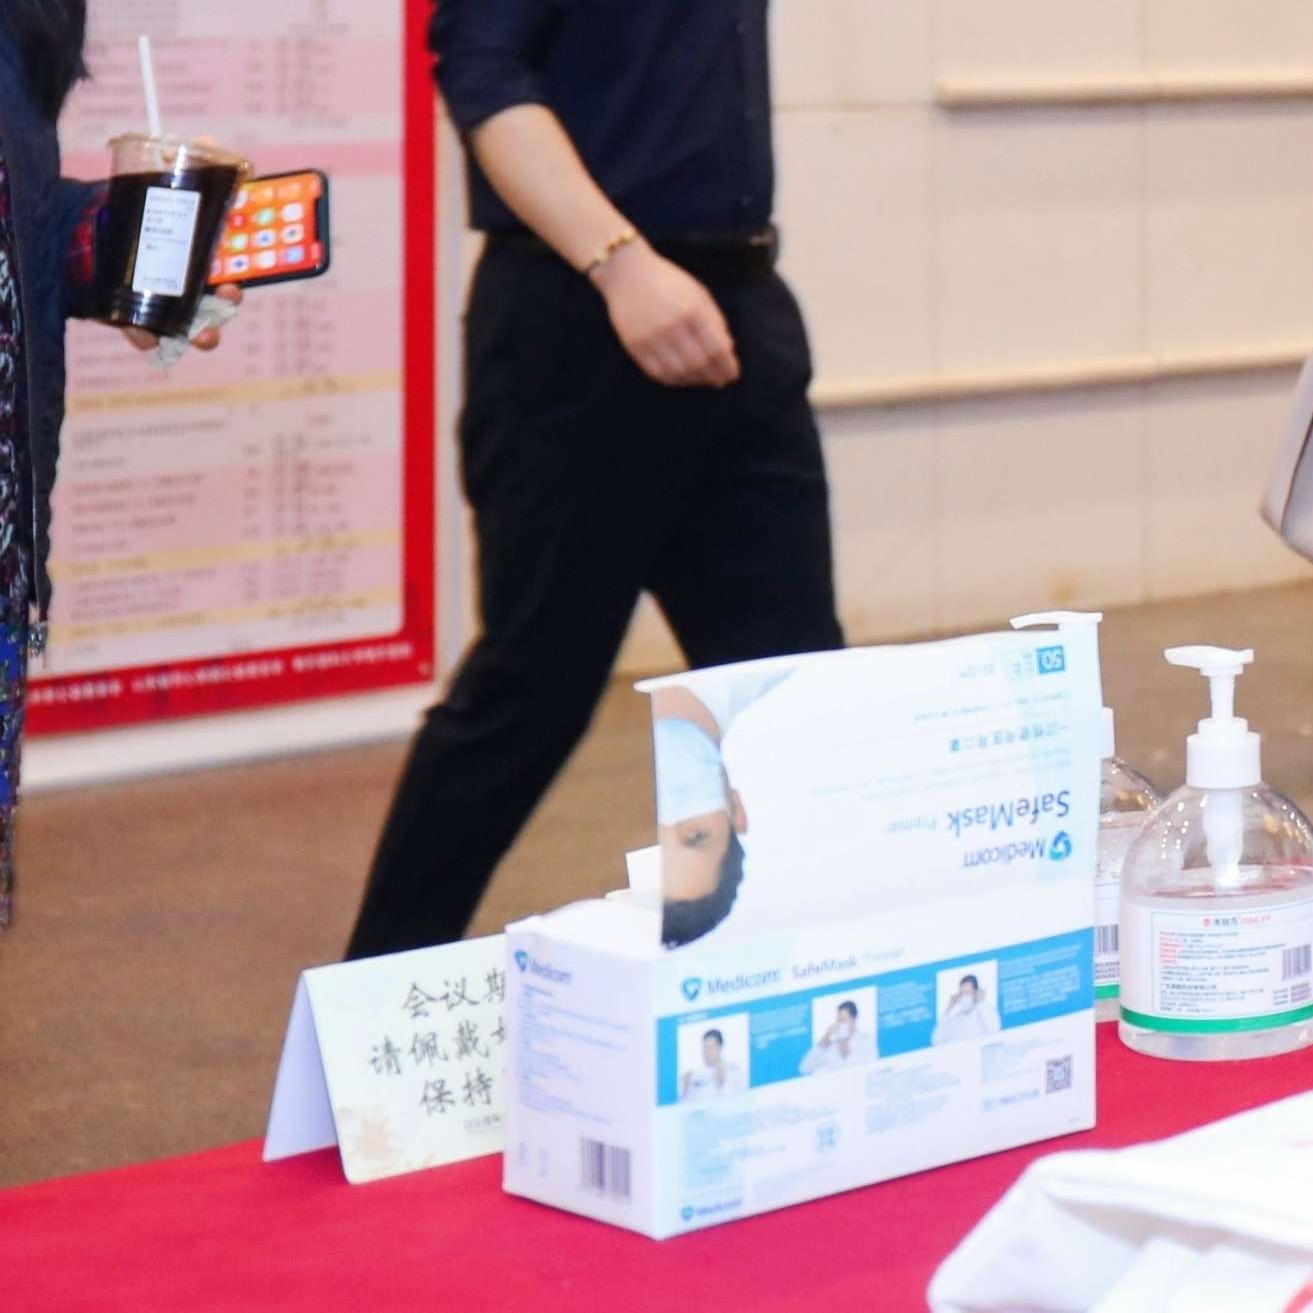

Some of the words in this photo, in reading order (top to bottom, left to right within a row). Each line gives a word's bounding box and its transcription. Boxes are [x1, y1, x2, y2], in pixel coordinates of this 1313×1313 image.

[947, 791, 1070, 837] SafeMask
[963, 838, 1046, 867] Medicom
[707, 969, 781, 995] Medicom
[792, 952, 857, 978] SafeMask
[420, 1068, 493, 1116] 保持
